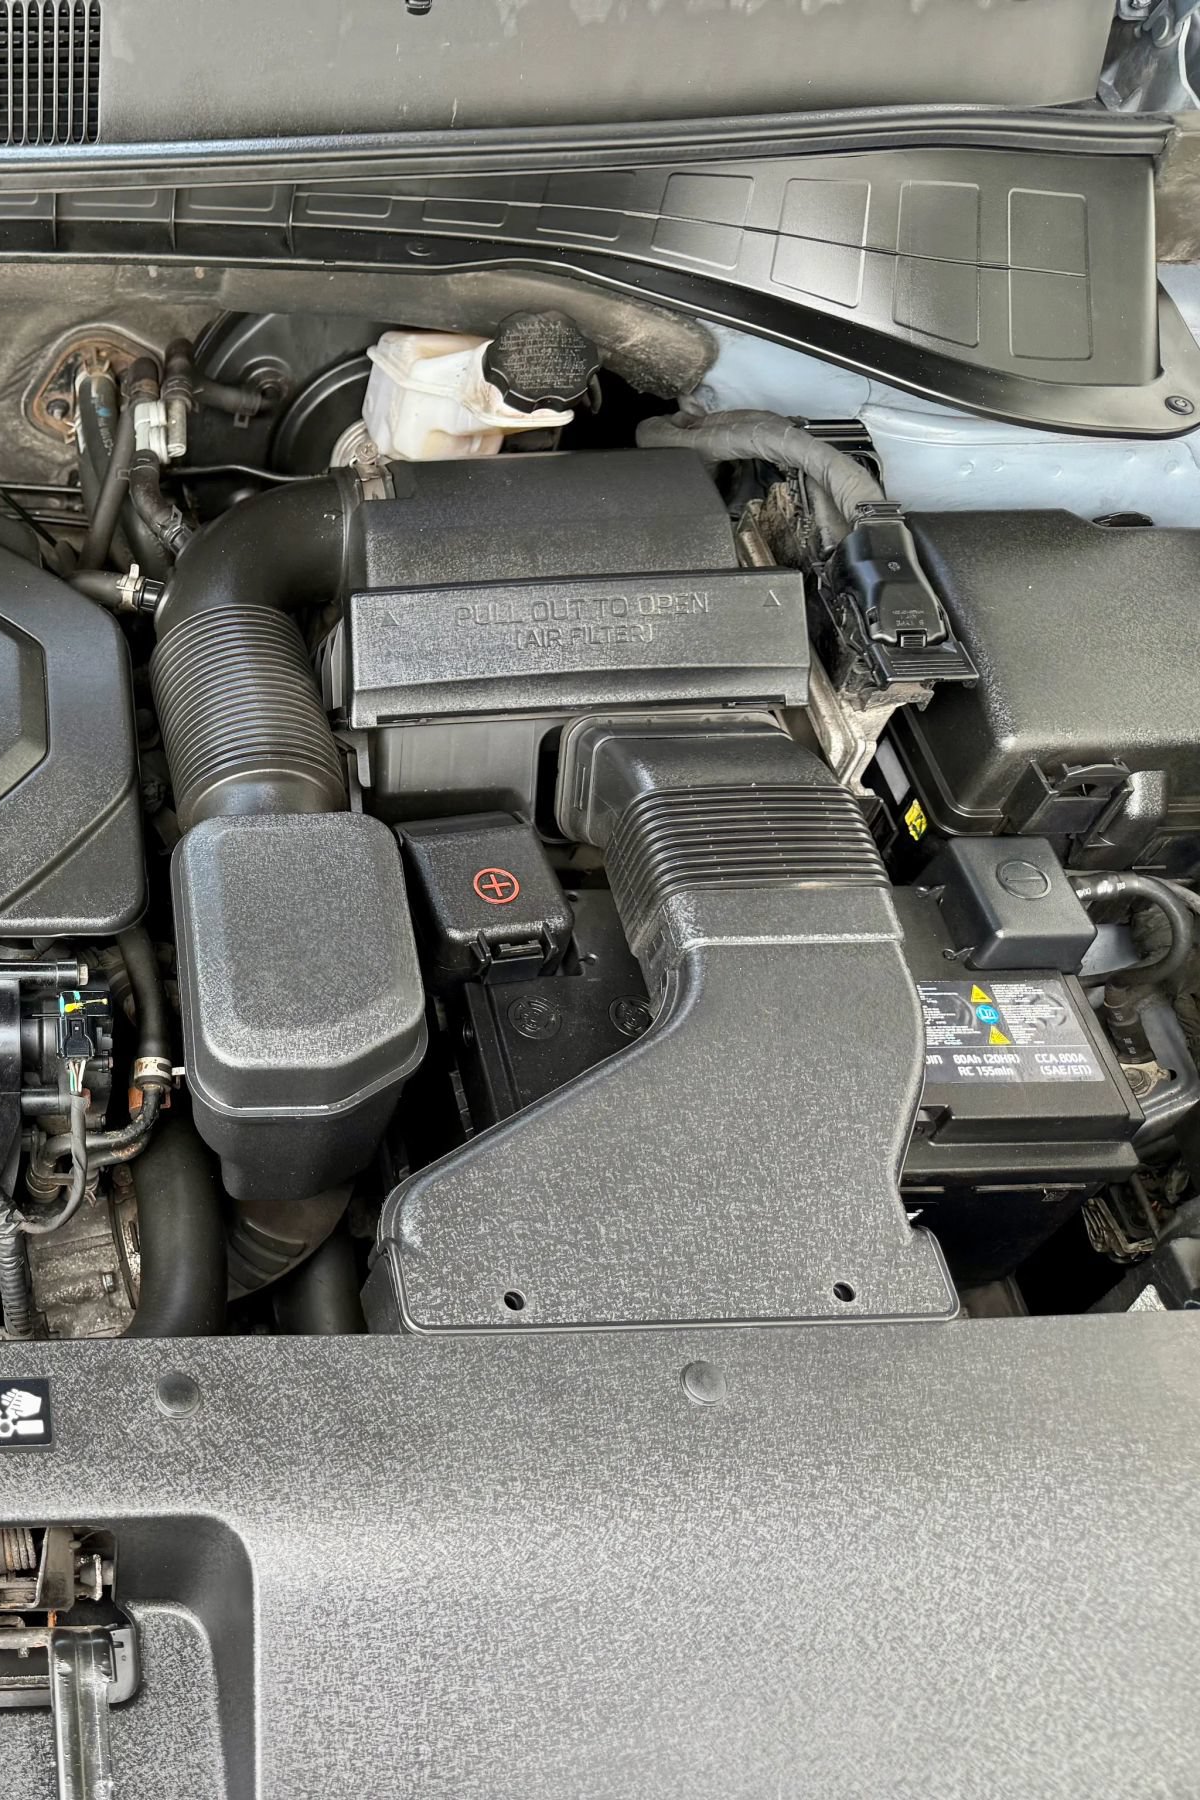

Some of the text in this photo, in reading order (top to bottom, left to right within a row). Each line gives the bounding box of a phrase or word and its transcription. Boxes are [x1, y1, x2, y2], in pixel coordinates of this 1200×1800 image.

[456, 591, 709, 626] PULL OUT TO OPEN
[983, 1053, 1020, 1063] (20HR)
[1034, 1052, 1058, 1063] CCA
[1059, 1052, 1087, 1063] 800A
[957, 1066, 974, 1076] RC
[975, 1065, 1014, 1076] 155min
